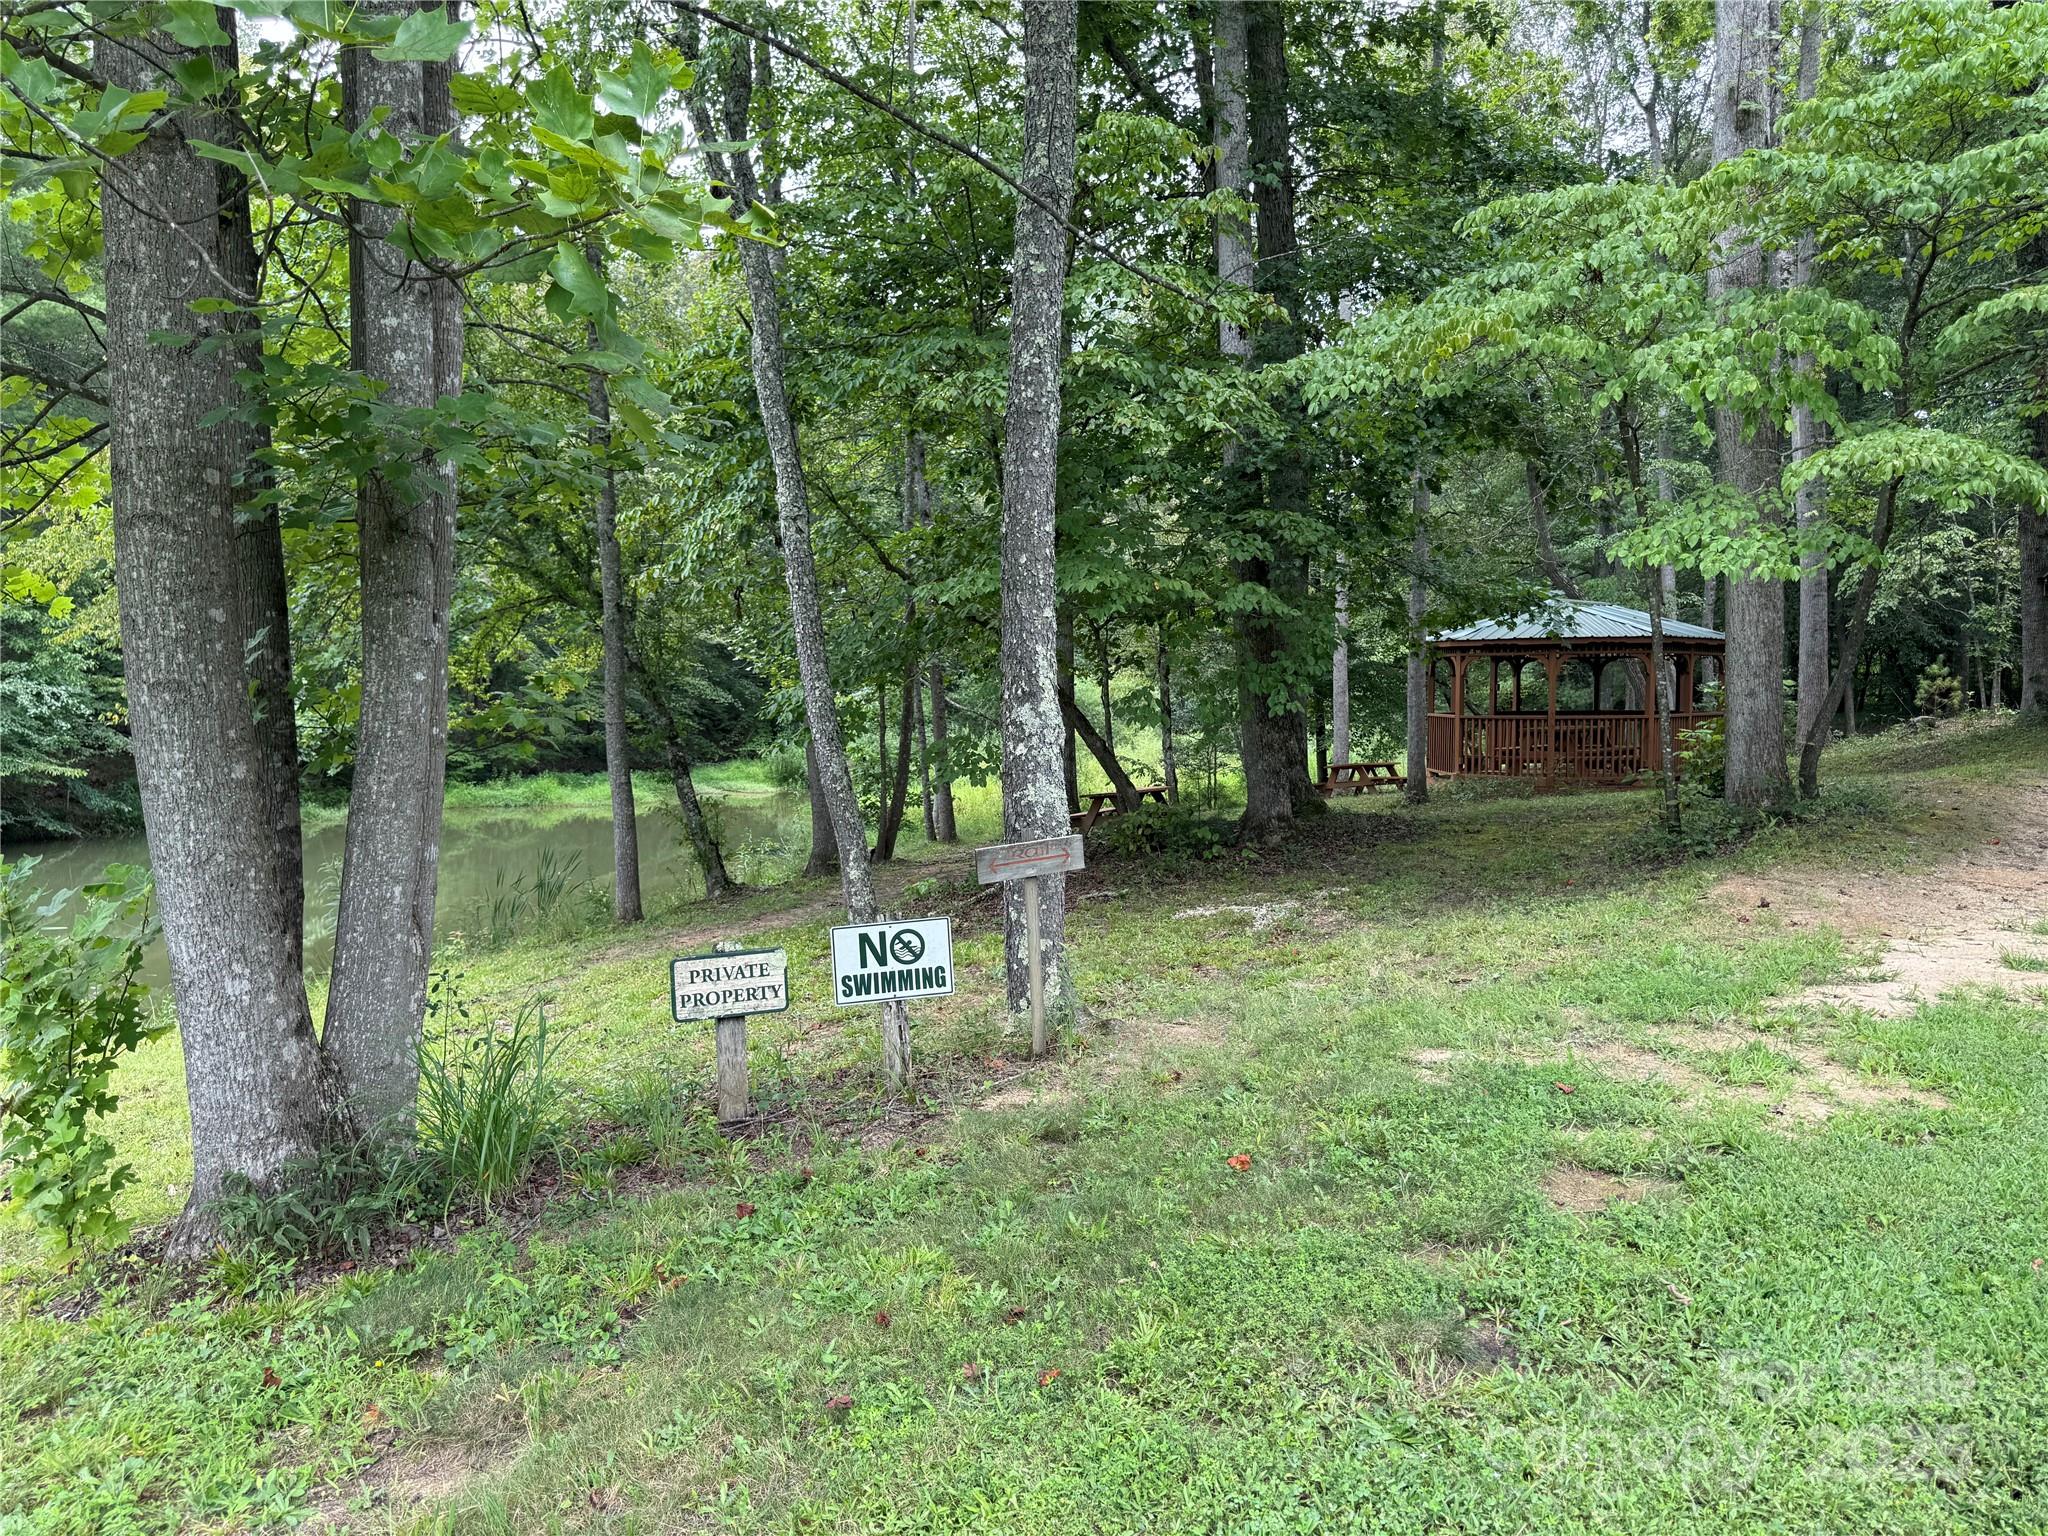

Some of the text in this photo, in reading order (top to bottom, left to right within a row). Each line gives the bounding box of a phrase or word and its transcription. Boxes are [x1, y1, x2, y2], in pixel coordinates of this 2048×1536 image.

[858, 928, 926, 969] NO
[688, 962, 771, 985] PRIVATE
[841, 965, 947, 998] SWIMMING
[679, 983, 784, 1009] PROPERTY
